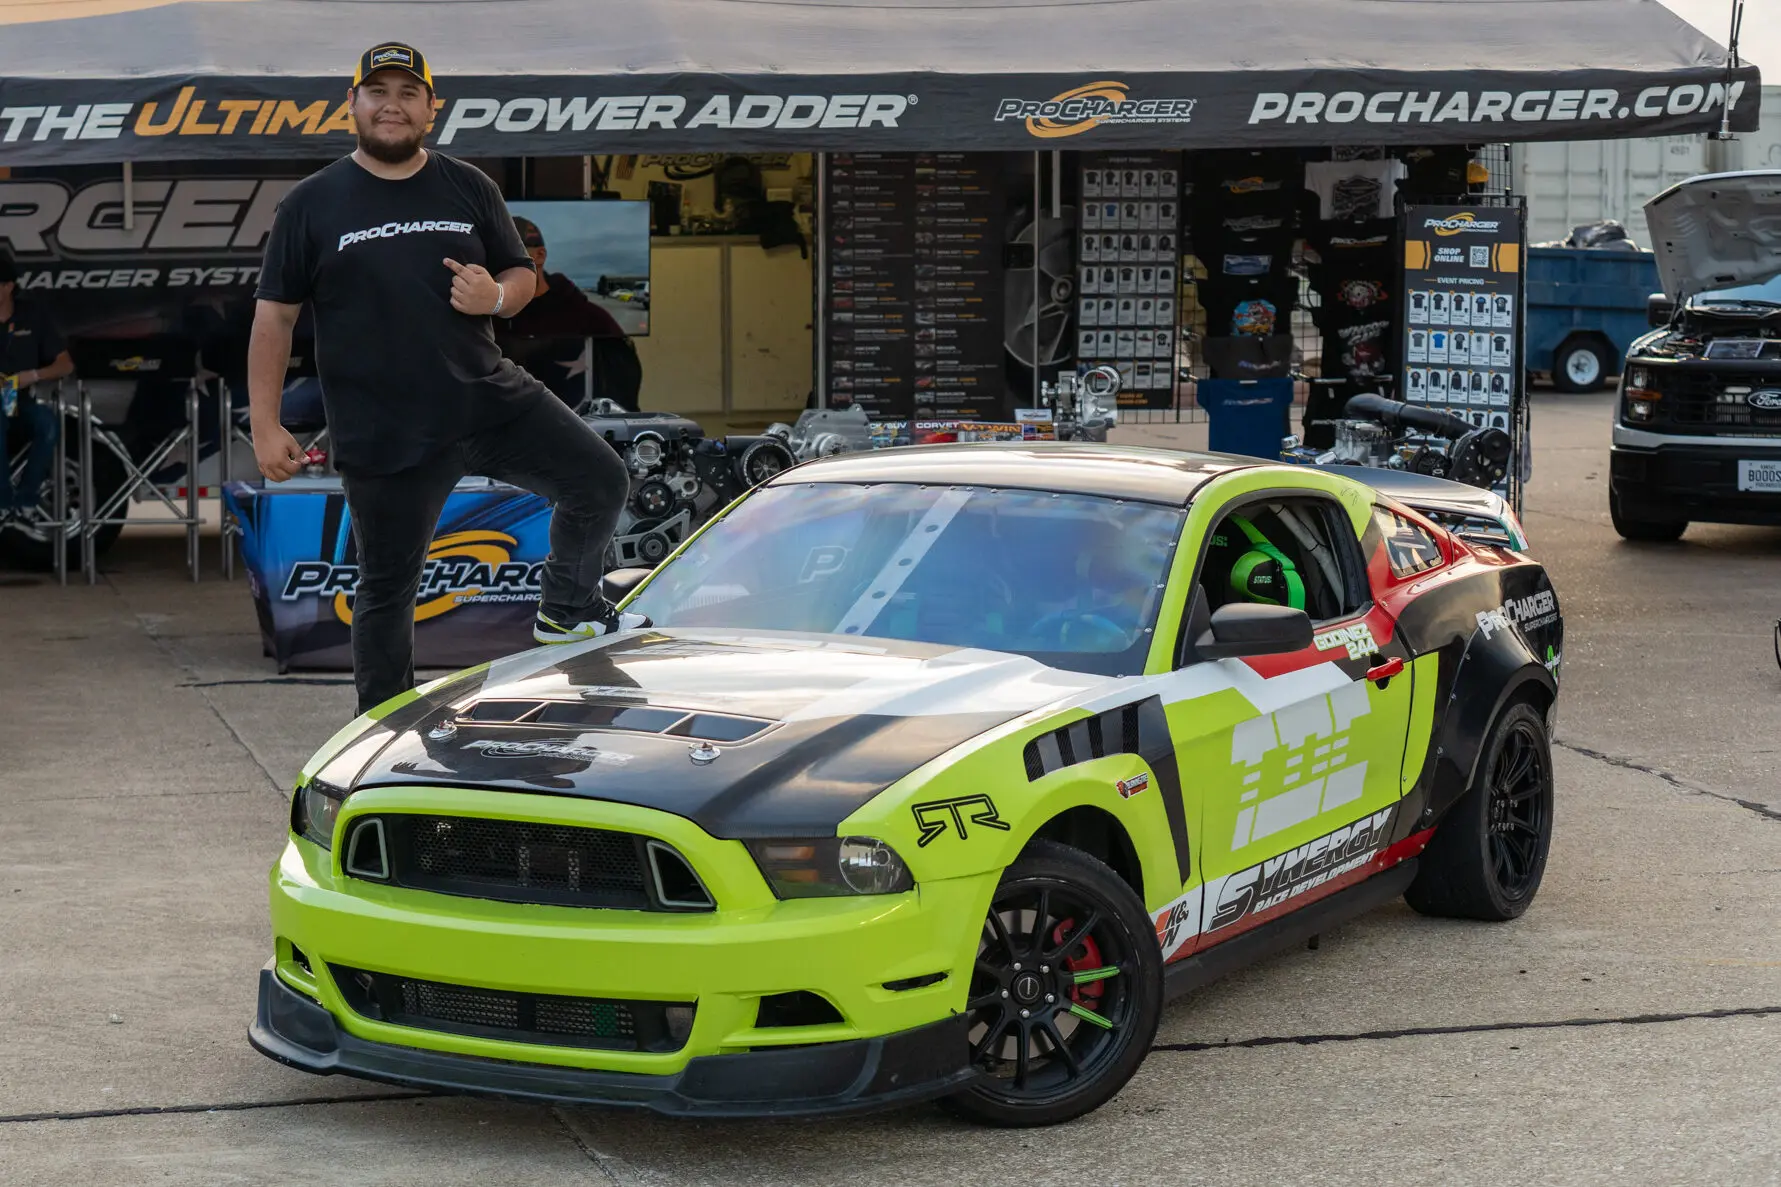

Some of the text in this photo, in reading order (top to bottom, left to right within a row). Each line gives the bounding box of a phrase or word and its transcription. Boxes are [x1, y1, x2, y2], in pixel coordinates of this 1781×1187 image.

[3, 103, 134, 142] THE
[134, 86, 443, 136] ULTIMA
[437, 96, 687, 145] POWER
[1248, 81, 1745, 125] PROCHARGER.COM
[337, 220, 474, 251] PROCHARGER
[1434, 255, 1465, 263] ONLINE
[1437, 247, 1462, 255] SHOP
[167, 266, 262, 287] SYST
[1437, 277, 1485, 286] EVENT PRICING
[1313, 622, 1372, 652] GODINEZ
[1345, 636, 1379, 661] 244
[1207, 806, 1394, 934] SYNERGY
[1252, 848, 1378, 915] RACE DEVELOPMENT
